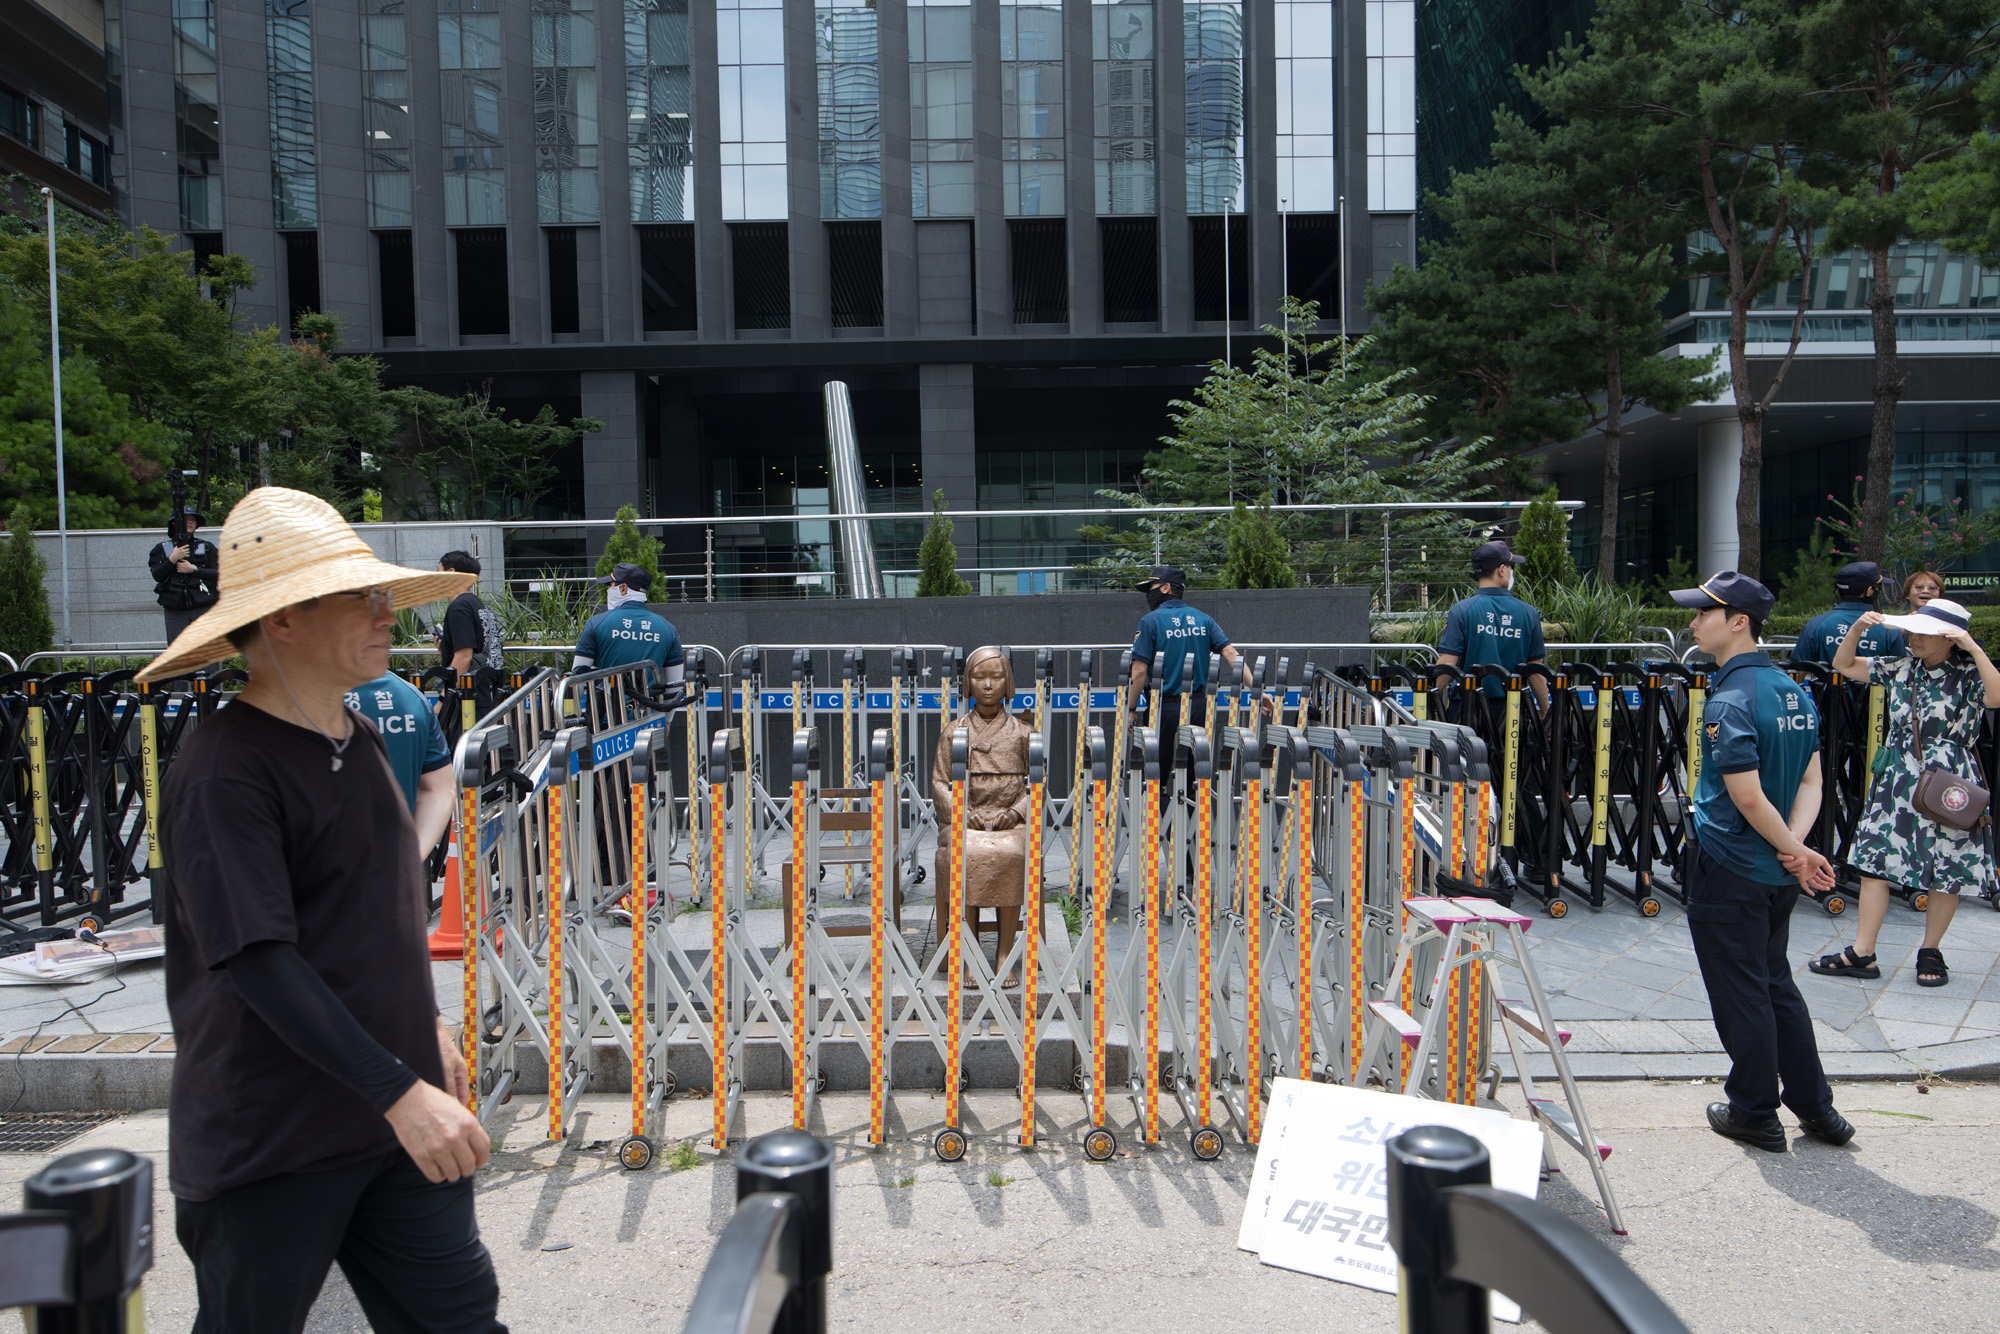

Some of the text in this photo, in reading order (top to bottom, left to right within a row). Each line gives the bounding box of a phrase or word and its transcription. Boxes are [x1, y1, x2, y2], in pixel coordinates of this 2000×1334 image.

[1943, 576, 1999, 587] ARBUCKS
[611, 629, 660, 643] POLICE
[1166, 626, 1207, 639] POLICE
[1476, 624, 1522, 638] POLICE
[1825, 635, 1878, 651] POCE
[377, 714, 416, 734] ICE
[596, 733, 629, 761] OLICE
[1510, 719, 1519, 780] POLICE
[1693, 716, 1703, 778] POLICE
[142, 734, 156, 851] POLICE LINE
